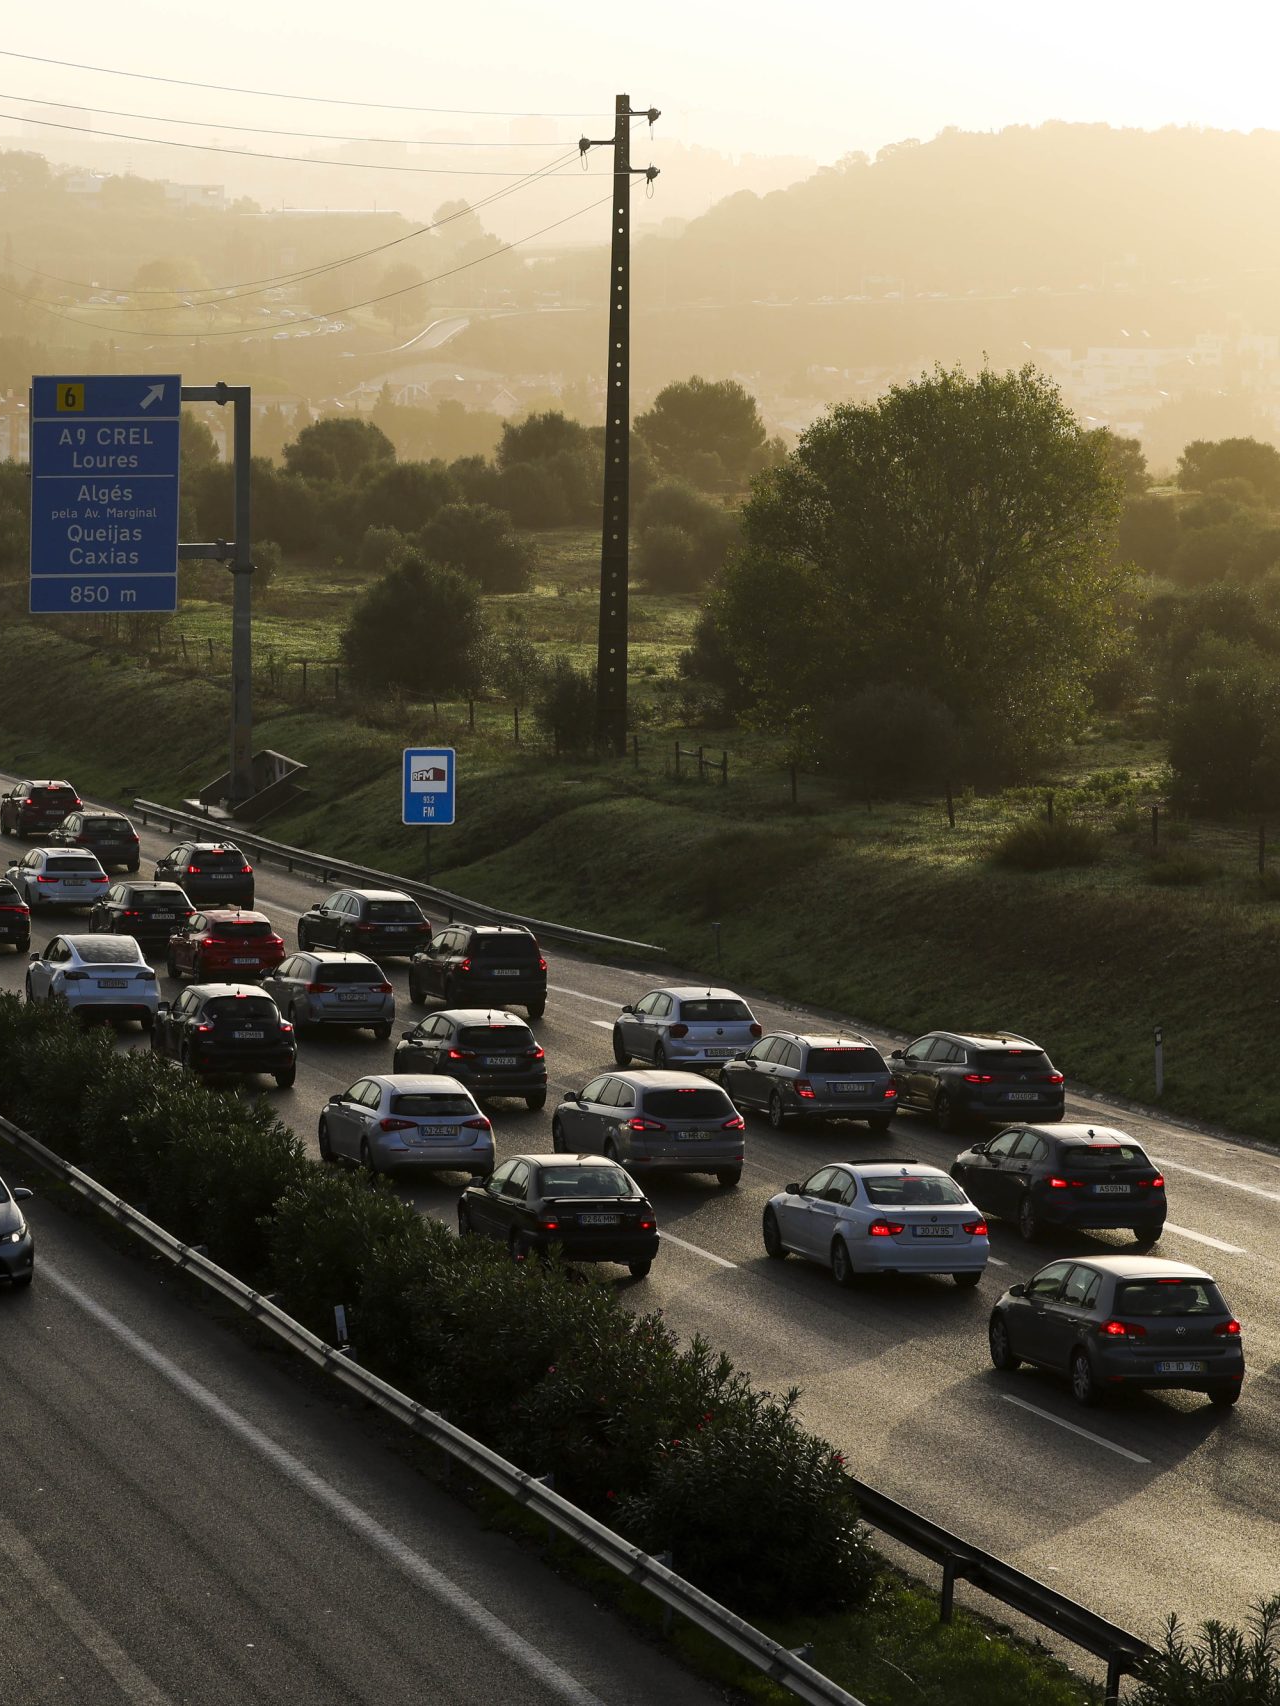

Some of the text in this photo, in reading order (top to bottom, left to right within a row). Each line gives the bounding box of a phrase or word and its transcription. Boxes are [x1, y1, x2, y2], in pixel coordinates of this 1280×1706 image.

[64, 387, 76, 408] 6
[59, 428, 154, 446] A9 CREL
[73, 451, 138, 469] Loures
[77, 484, 133, 505] Algés
[51, 507, 157, 520] pela Av. Marginal
[67, 525, 142, 545] Queijas
[69, 548, 139, 565] Caxias
[70, 585, 137, 602] 850 m
[412, 767, 434, 781] RFM
[423, 796, 435, 804] 93.2
[423, 806, 435, 817] FM
